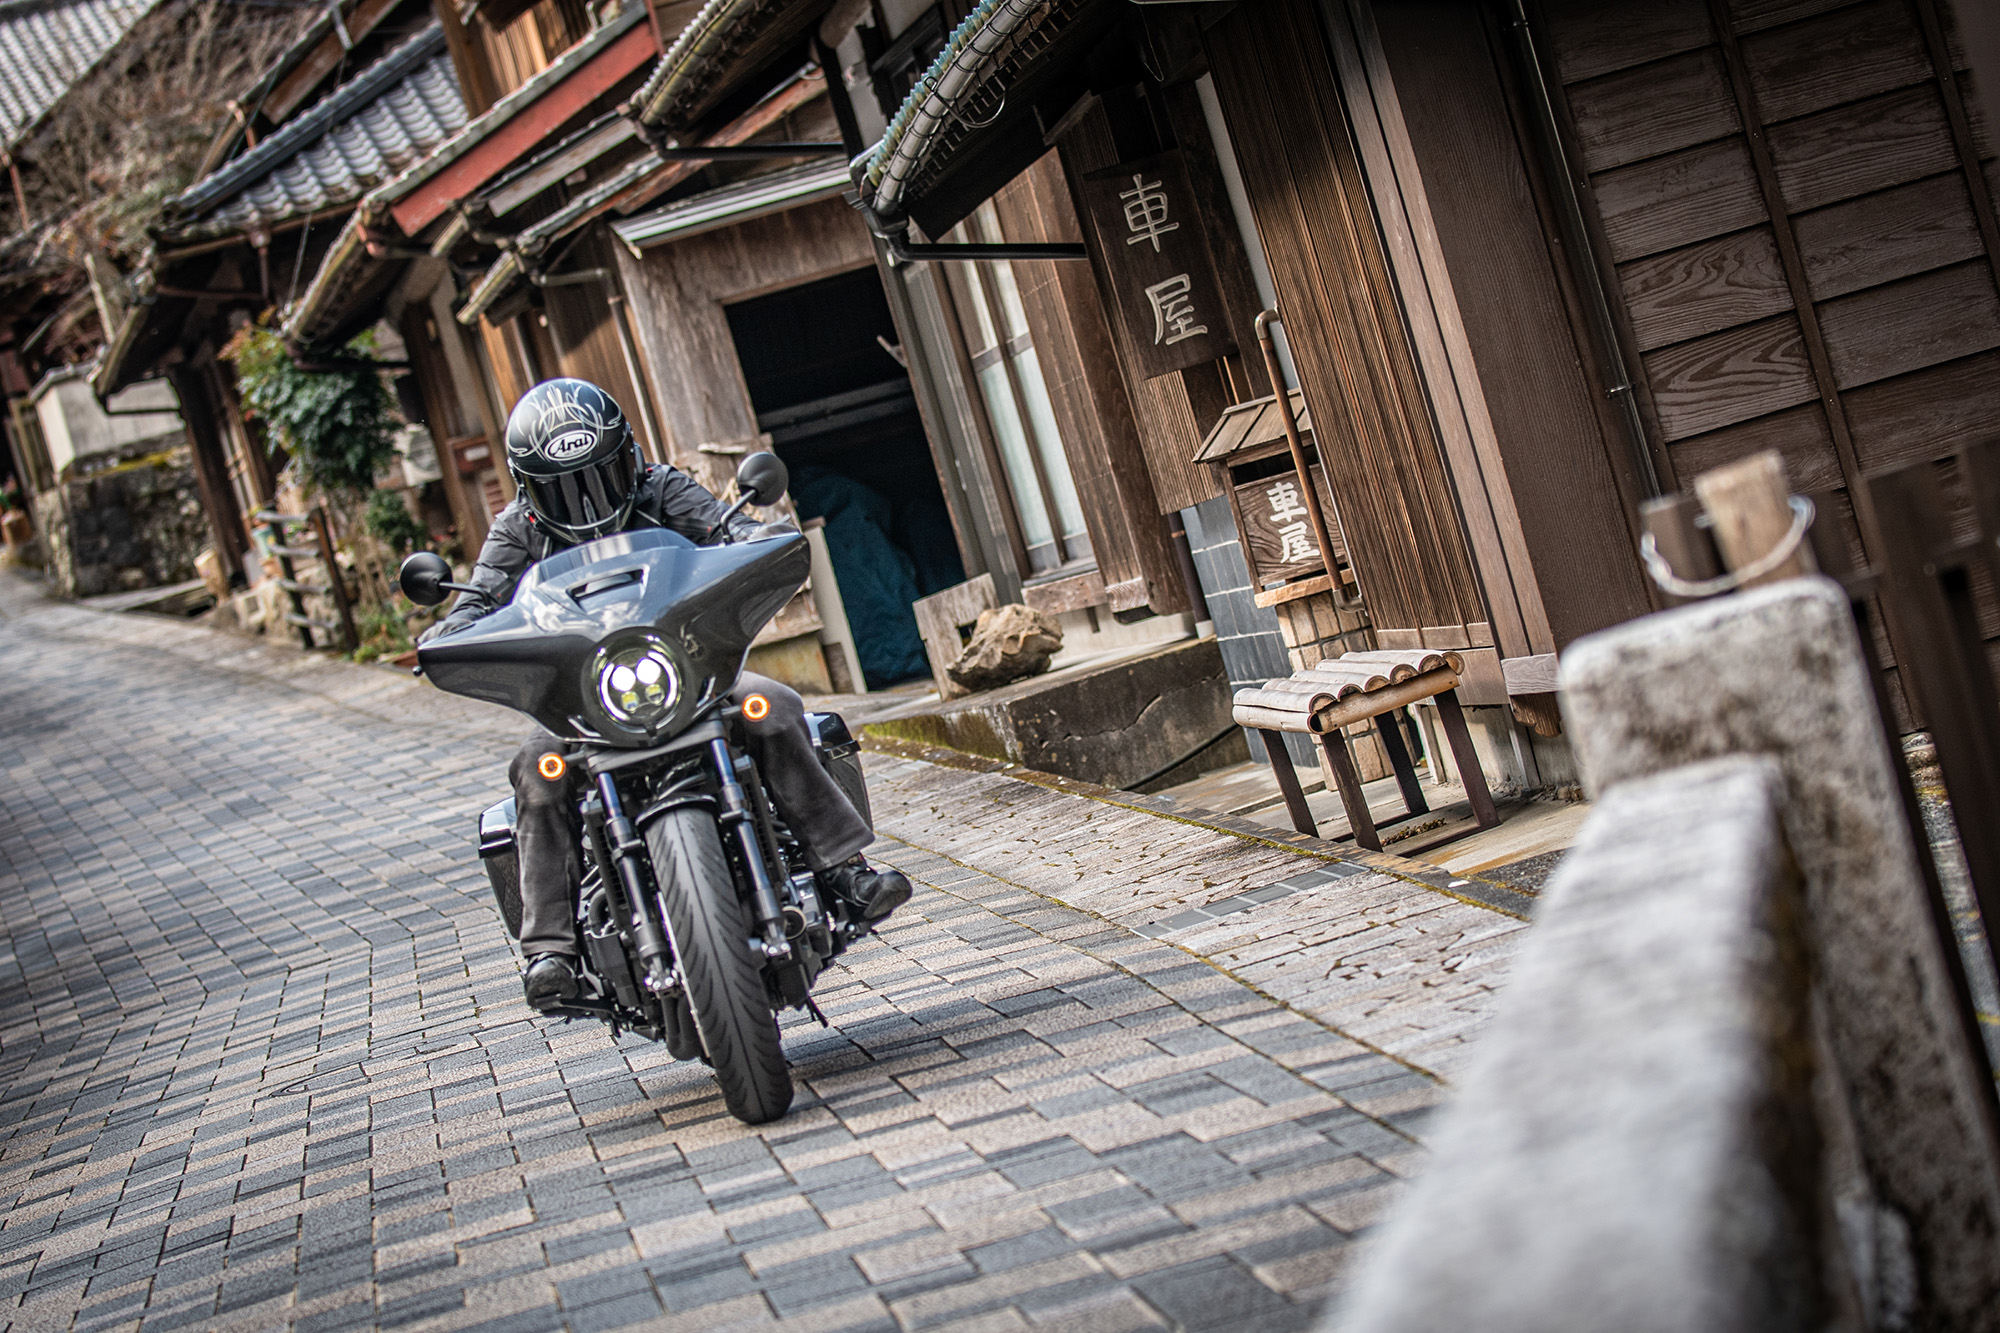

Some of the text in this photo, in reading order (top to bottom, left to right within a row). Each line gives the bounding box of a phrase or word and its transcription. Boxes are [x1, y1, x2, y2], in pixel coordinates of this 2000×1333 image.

[1119, 173, 1208, 346] 車屋
[552, 433, 589, 456] Arai
[1266, 482, 1320, 564] 車屋
